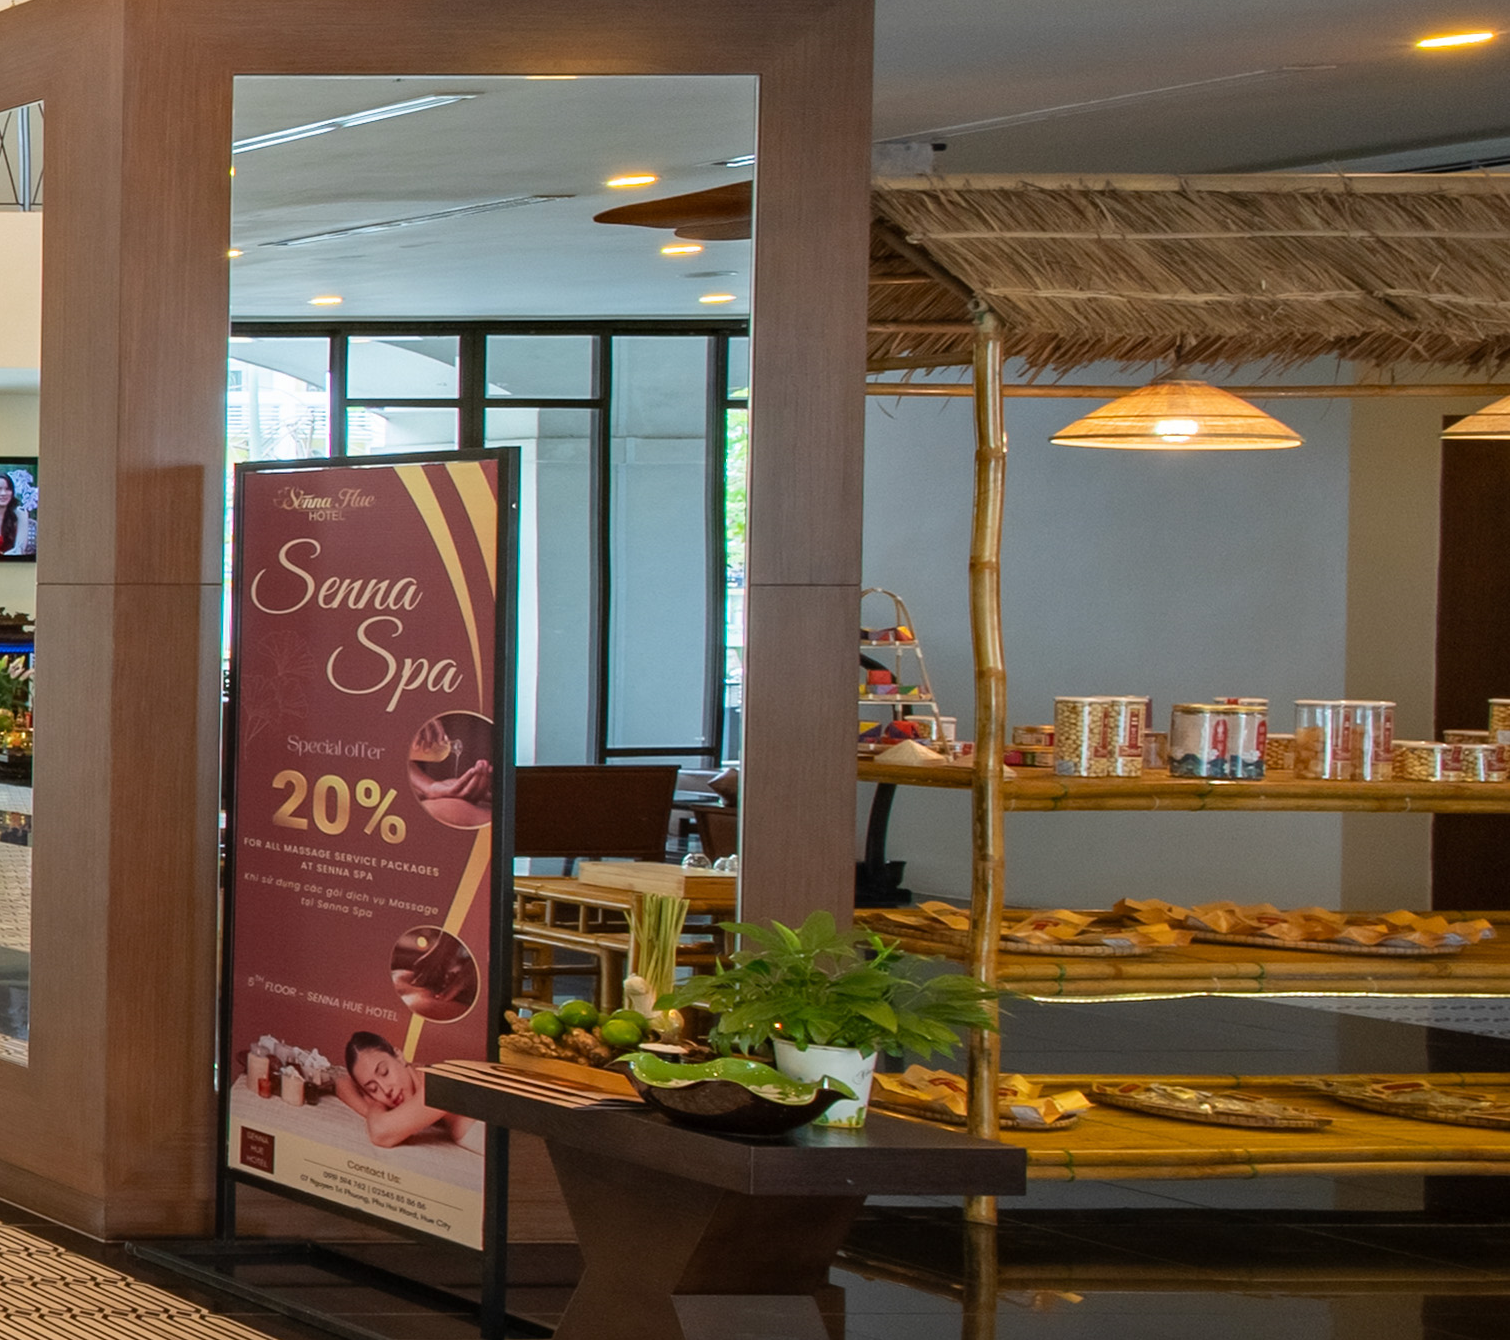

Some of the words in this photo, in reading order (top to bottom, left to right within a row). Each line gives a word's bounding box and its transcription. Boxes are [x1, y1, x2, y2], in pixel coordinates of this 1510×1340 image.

[282, 487, 332, 510] Senna
[335, 488, 375, 509] Hue
[308, 510, 346, 521] HOTEL
[251, 538, 423, 614] Senna
[327, 616, 463, 712] Spa
[287, 735, 342, 756] Special
[344, 741, 386, 760] offer
[272, 769, 406, 844] 20%
[244, 837, 262, 848] FOR
[265, 841, 281, 851] ALL
[283, 844, 331, 859] MASSAGE
[334, 852, 377, 867] SERVICE
[380, 859, 439, 877] PACKAGES
[300, 861, 313, 871] AT
[316, 863, 349, 877] SENNA
[353, 869, 373, 881] SPA
[317, 900, 349, 914] Senna
[352, 906, 373, 918] Spa
[389, 898, 439, 916] Massage
[264, 980, 297, 997] FLOOR
[307, 991, 340, 1007] SENNA
[342, 999, 364, 1014] HUE
[365, 1005, 398, 1022] HOTEL
[347, 1160, 385, 1179] Contact
